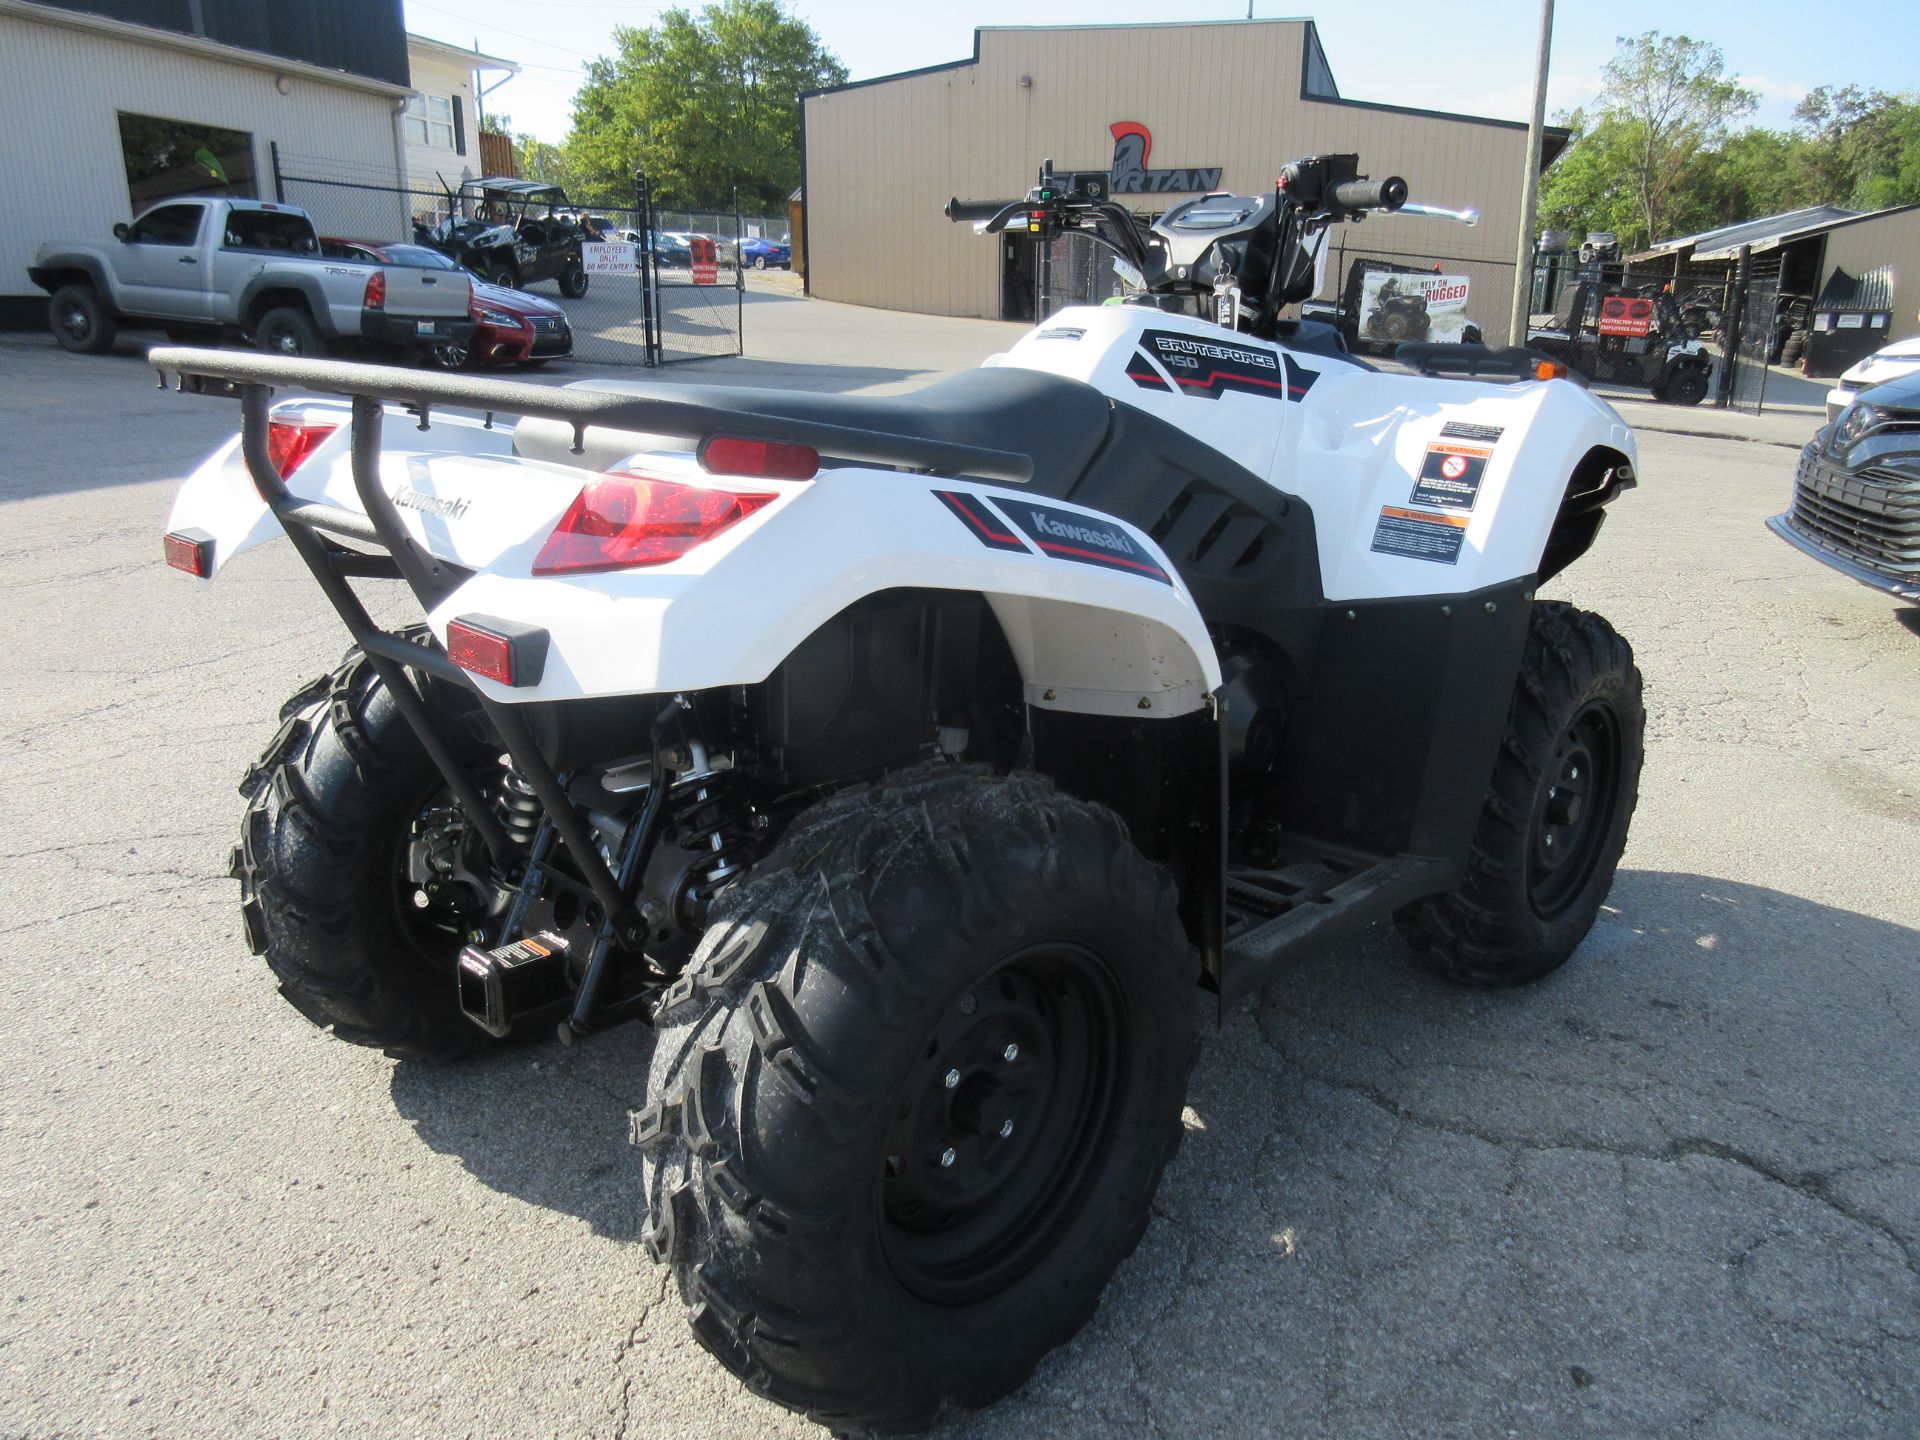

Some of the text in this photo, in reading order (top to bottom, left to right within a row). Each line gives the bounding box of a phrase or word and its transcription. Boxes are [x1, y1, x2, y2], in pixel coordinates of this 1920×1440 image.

[590, 246, 627, 254] EMPLOYEES
[597, 263, 608, 271] NOT
[609, 263, 633, 271] ENTER!
[1420, 279, 1448, 289] RELY ON
[1425, 285, 1467, 302] RUGGED
[1162, 352, 1200, 369] 450
[1446, 446, 1484, 456] WARNING
[391, 485, 472, 520] Kawasaki
[1410, 511, 1444, 523] WARNING
[1030, 511, 1134, 554] Kawasaki
